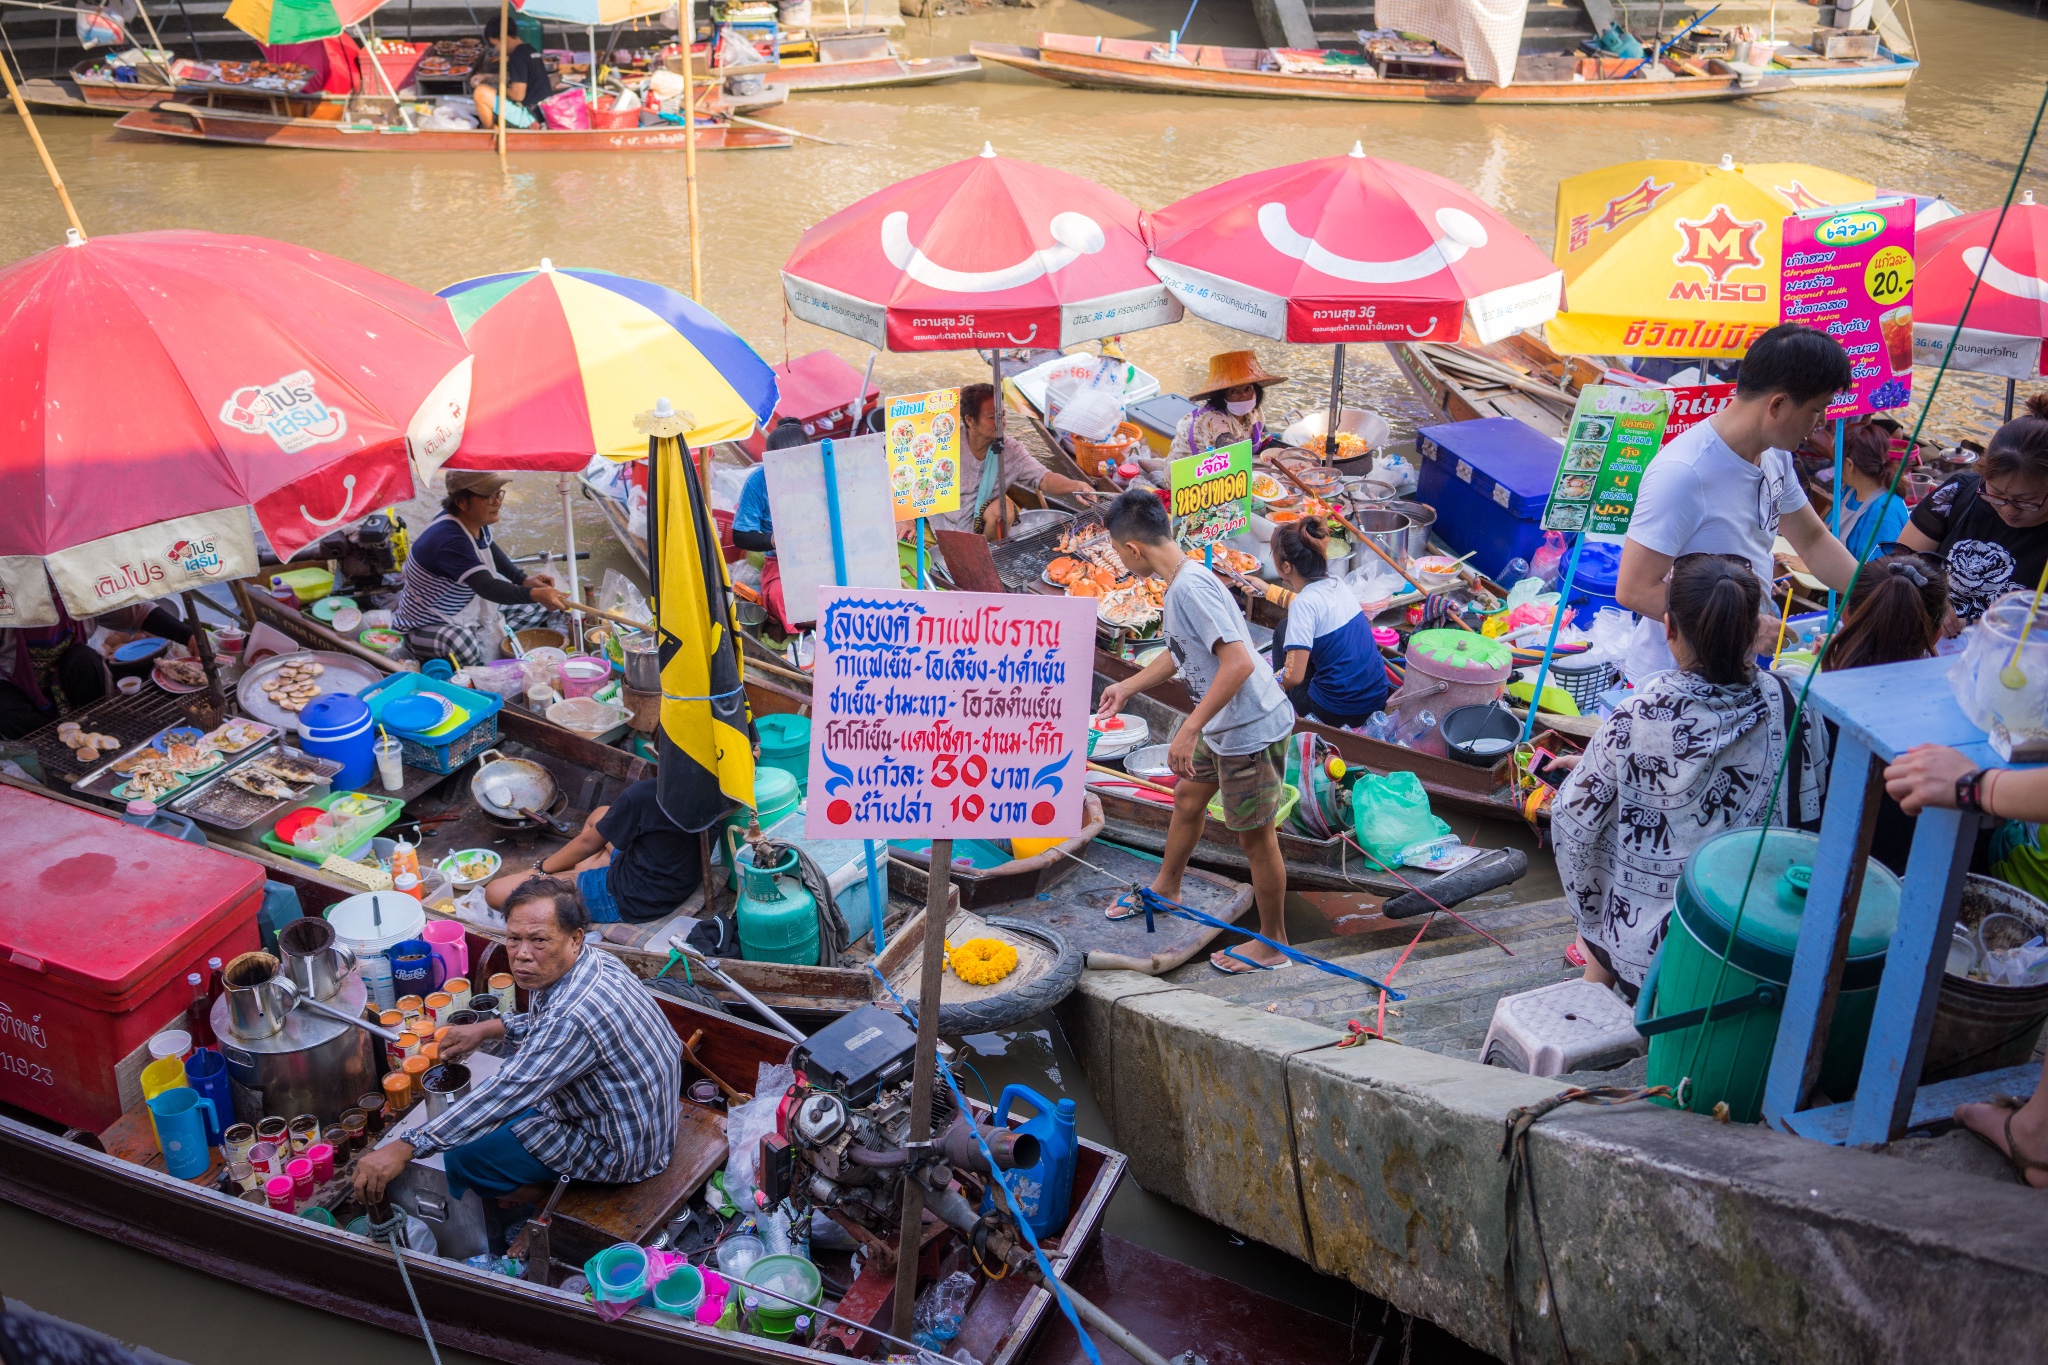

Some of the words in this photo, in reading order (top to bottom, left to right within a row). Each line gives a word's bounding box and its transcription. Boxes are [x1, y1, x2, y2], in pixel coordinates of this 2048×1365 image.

[1694, 228, 1745, 260] M
[1783, 261, 1861, 278] Chrysanthemum
[1875, 252, 1907, 269] แก้วละ
[1160, 274, 1182, 289] dtac
[1182, 283, 1194, 294] 3G
[1196, 288, 1209, 299] 4G
[1668, 281, 1767, 303] M-150
[1786, 276, 1833, 291] มะพร้าว
[1783, 290, 1824, 301] Coconut
[1827, 287, 1848, 296] milk
[1313, 309, 1356, 322] ความสุข
[1358, 306, 1376, 318] 3G
[1787, 299, 1847, 315] น้ำตาลสด
[913, 317, 955, 331] ความสุข
[957, 315, 975, 327] 3G
[1072, 314, 1092, 326] dtac
[1093, 312, 1103, 321] 3G
[1105, 308, 1116, 318] 4G
[1814, 314, 1840, 322] Juice
[1915, 338, 1927, 347] 3G
[1931, 340, 1943, 350] 4G
[264, 386, 313, 411] โปร
[267, 402, 329, 438] เสริม
[1176, 470, 1248, 517] หอยทอด
[1203, 523, 1219, 540] 30
[1224, 516, 1246, 532] บาท
[191, 540, 215, 556] โปร
[185, 553, 218, 571] เสริม
[94, 562, 165, 598] เติมโปร
[916, 605, 1062, 648] กาแฟโบราณ
[857, 754, 924, 788] แก้วละ
[930, 753, 988, 789] 30
[991, 766, 1031, 790] บาท
[854, 789, 933, 825] น้ำเปล่า
[950, 793, 985, 823] 10
[989, 801, 1027, 825] บาท
